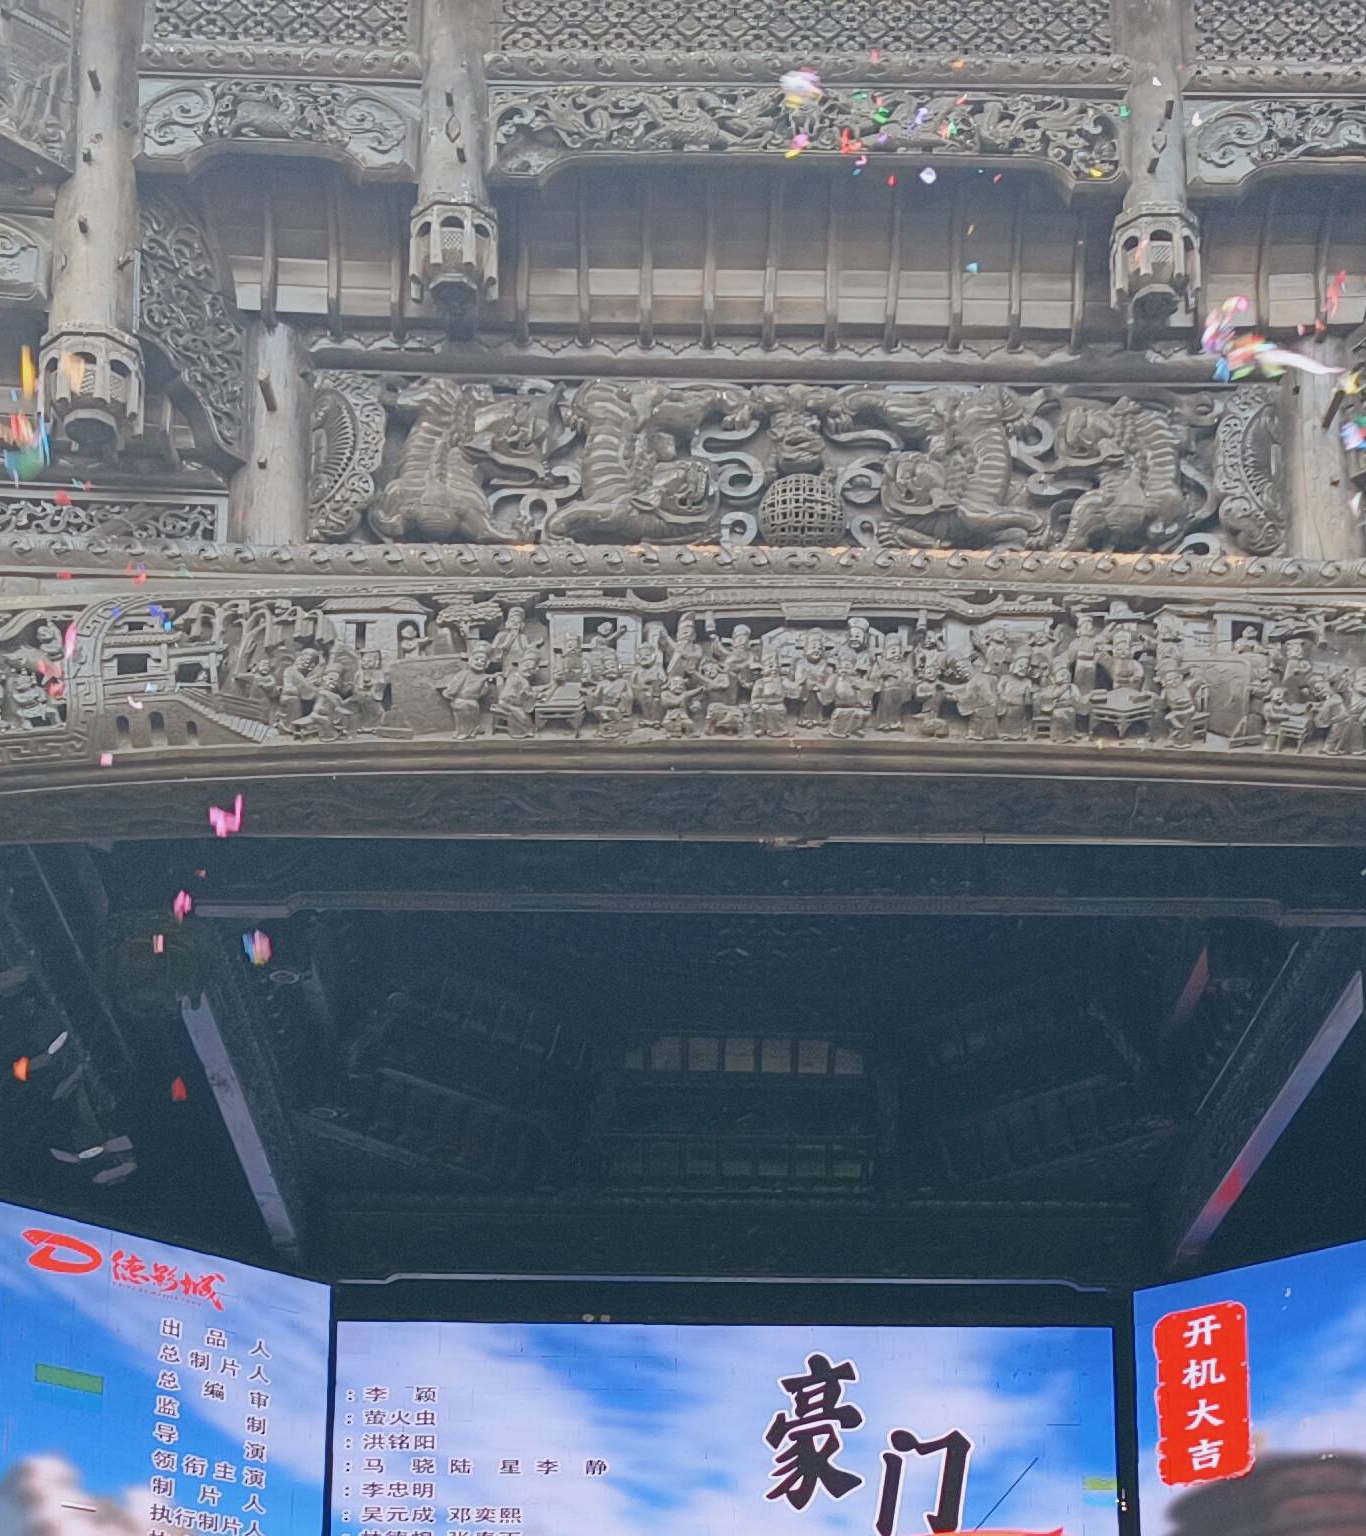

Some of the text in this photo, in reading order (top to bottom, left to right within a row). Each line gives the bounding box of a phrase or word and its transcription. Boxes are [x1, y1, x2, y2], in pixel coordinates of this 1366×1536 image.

[161, 1318, 271, 1360] 出品人
[159, 1344, 270, 1385] 总制片人
[157, 1371, 270, 1409] 总编审
[1182, 1314, 1227, 1471] 开机大吉
[152, 1450, 266, 1488] 领衔主演
[448, 1506, 522, 1524] 邓奕熙
[449, 1458, 522, 1475] 陆星
[536, 1458, 607, 1476] 李静
[151, 1475, 266, 1515] 制片人
